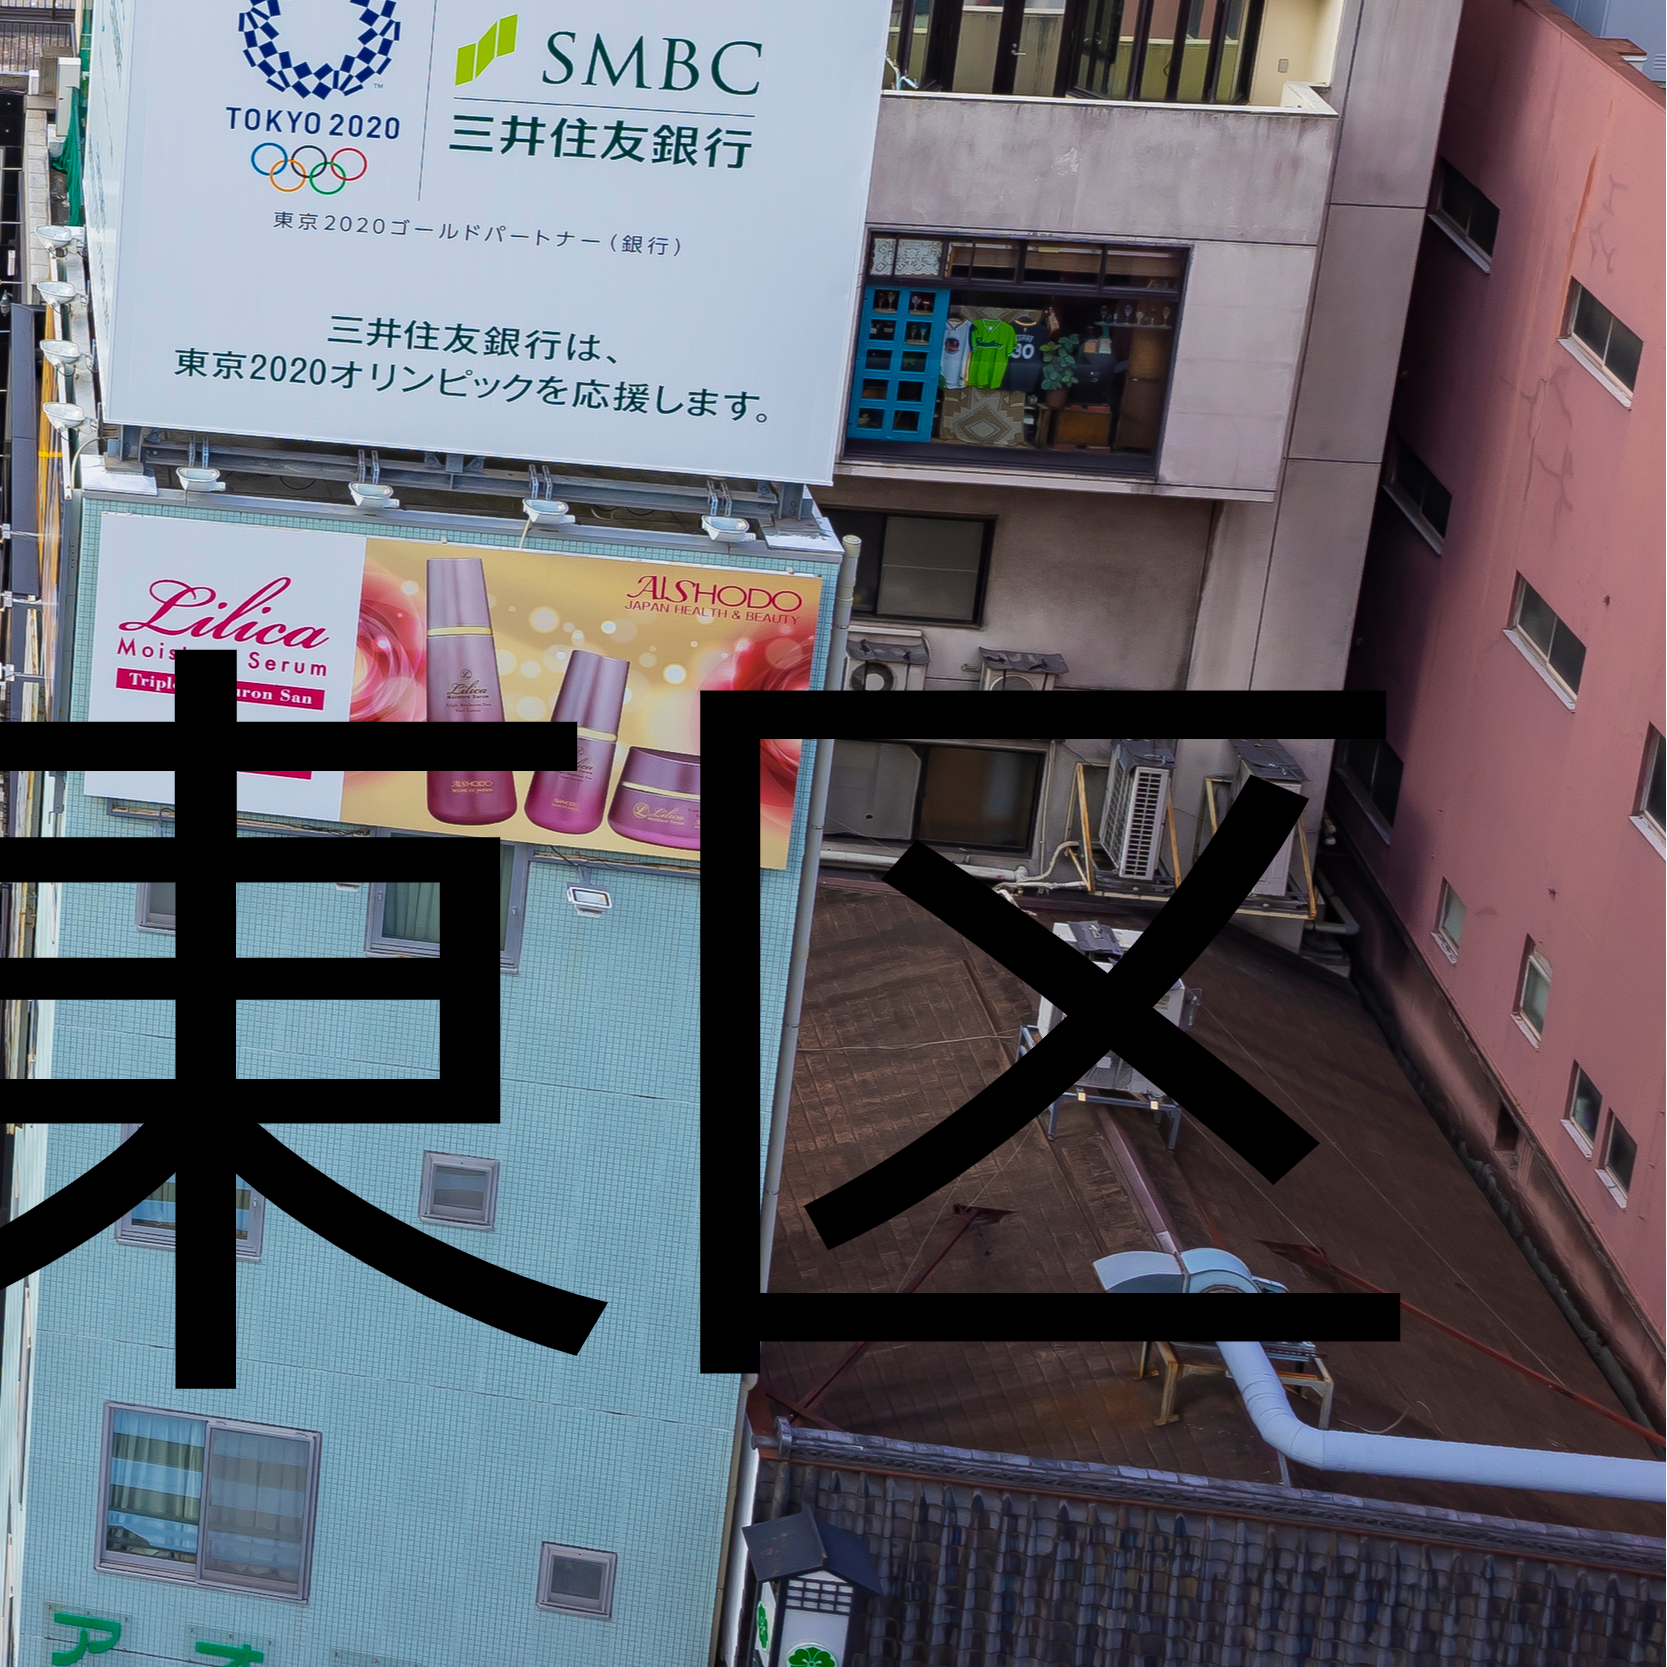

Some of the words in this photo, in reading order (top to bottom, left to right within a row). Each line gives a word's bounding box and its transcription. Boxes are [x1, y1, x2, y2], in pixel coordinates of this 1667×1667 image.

[543, 31, 763, 96] SMBC
[226, 107, 322, 134] TOKYO
[329, 113, 400, 140] 2020
[448, 113, 753, 169] 三井住友銀行
[327, 315, 618, 364] 三井住友銀行は、
[1013, 343, 1035, 359] 30
[174, 348, 768, 425] 東京2020オリンピックを応援します。
[119, 577, 330, 649] Lilica
[624, 599, 670, 614] JAPAN
[674, 605, 728, 618] HEALTH
[731, 609, 741, 620] &
[745, 612, 800, 626] BEAUTY
[248, 651, 327, 677] Serum
[280, 689, 311, 705] San
